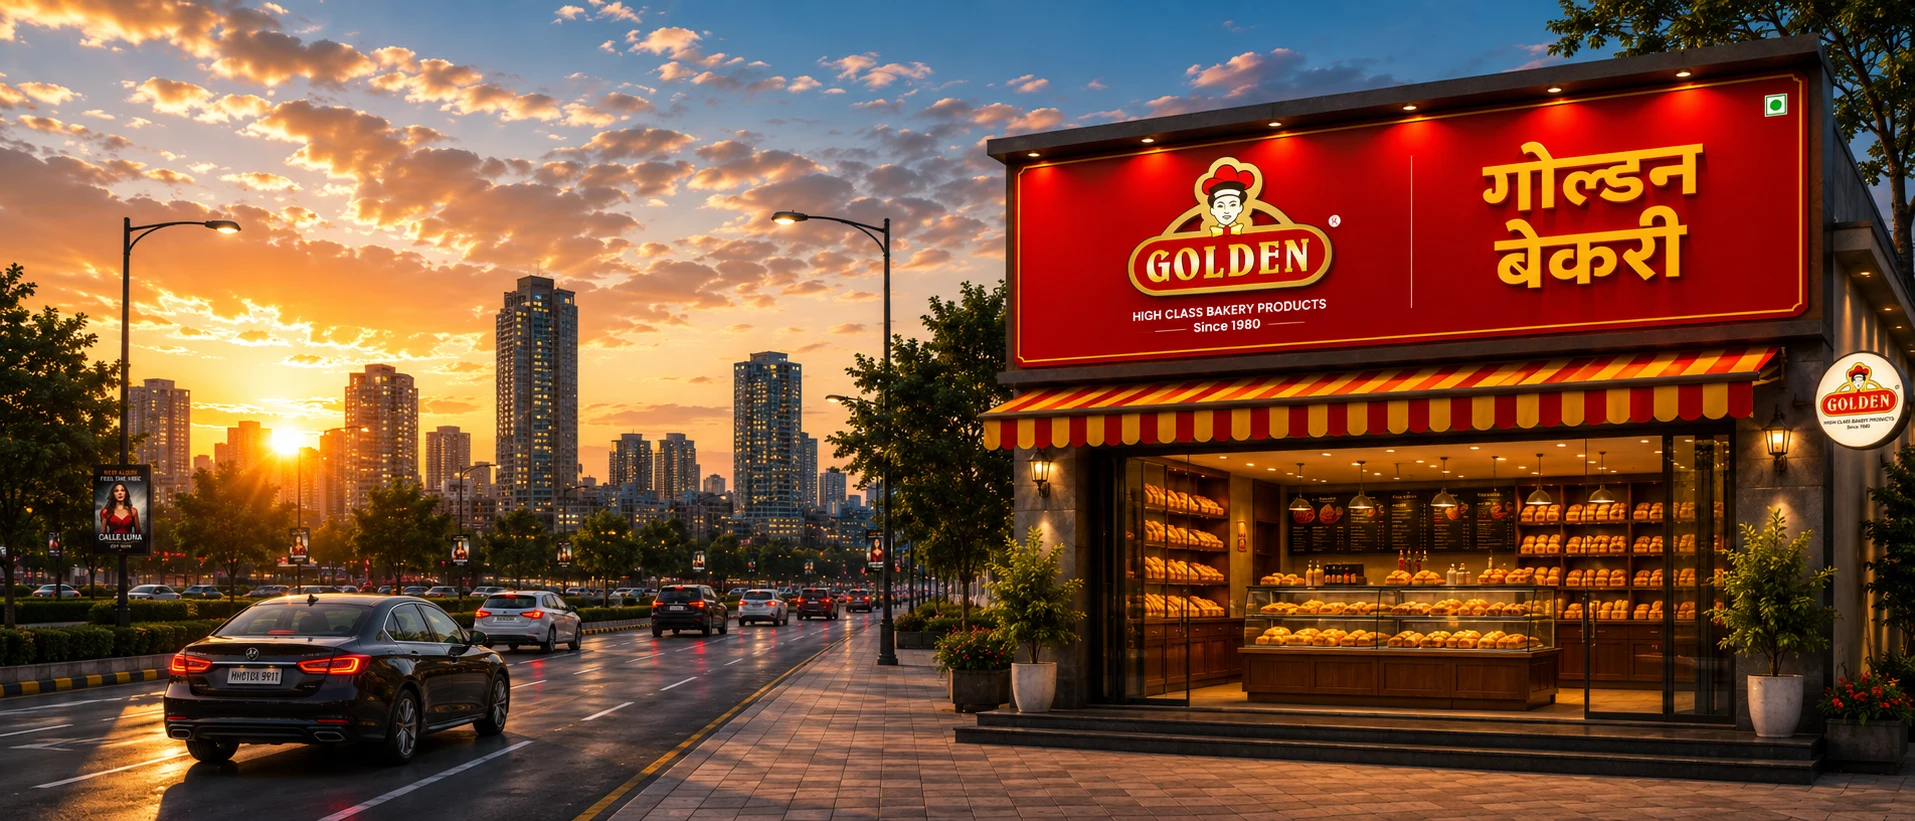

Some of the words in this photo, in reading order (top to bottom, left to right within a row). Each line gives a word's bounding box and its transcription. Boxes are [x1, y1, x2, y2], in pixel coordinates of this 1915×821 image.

[1481, 141, 1704, 212] गोल्डन
[1493, 205, 1689, 289] बेकरी
[1146, 238, 1310, 283] GOLDEN
[1132, 310, 1162, 322] HIGH
[1165, 307, 1203, 319] CLASS
[1206, 303, 1255, 317] BAKERY
[1257, 298, 1327, 314] PRODUCTS
[1193, 320, 1228, 333] Since
[1231, 318, 1261, 331] 1980
[1827, 394, 1890, 412] GOLDEN
[122, 533, 142, 541] LUNA
